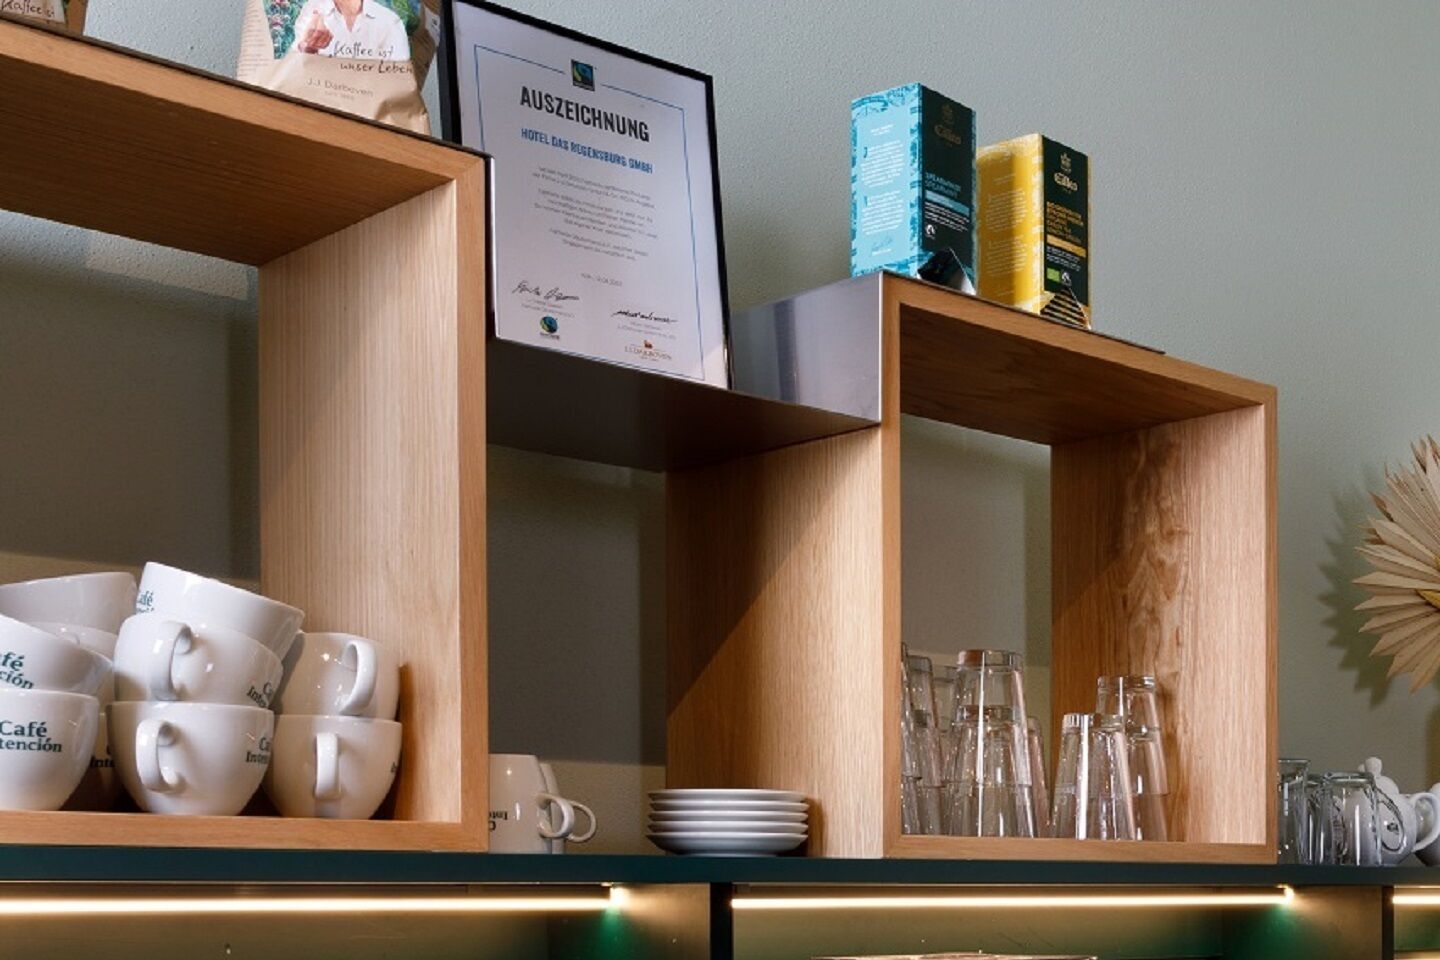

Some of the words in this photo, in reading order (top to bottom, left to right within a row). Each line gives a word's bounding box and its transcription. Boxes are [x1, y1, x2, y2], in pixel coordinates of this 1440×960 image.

[520, 86, 650, 142] AUSZEICHNUNG
[521, 127, 550, 146] HOTEL
[551, 135, 569, 151] DAS
